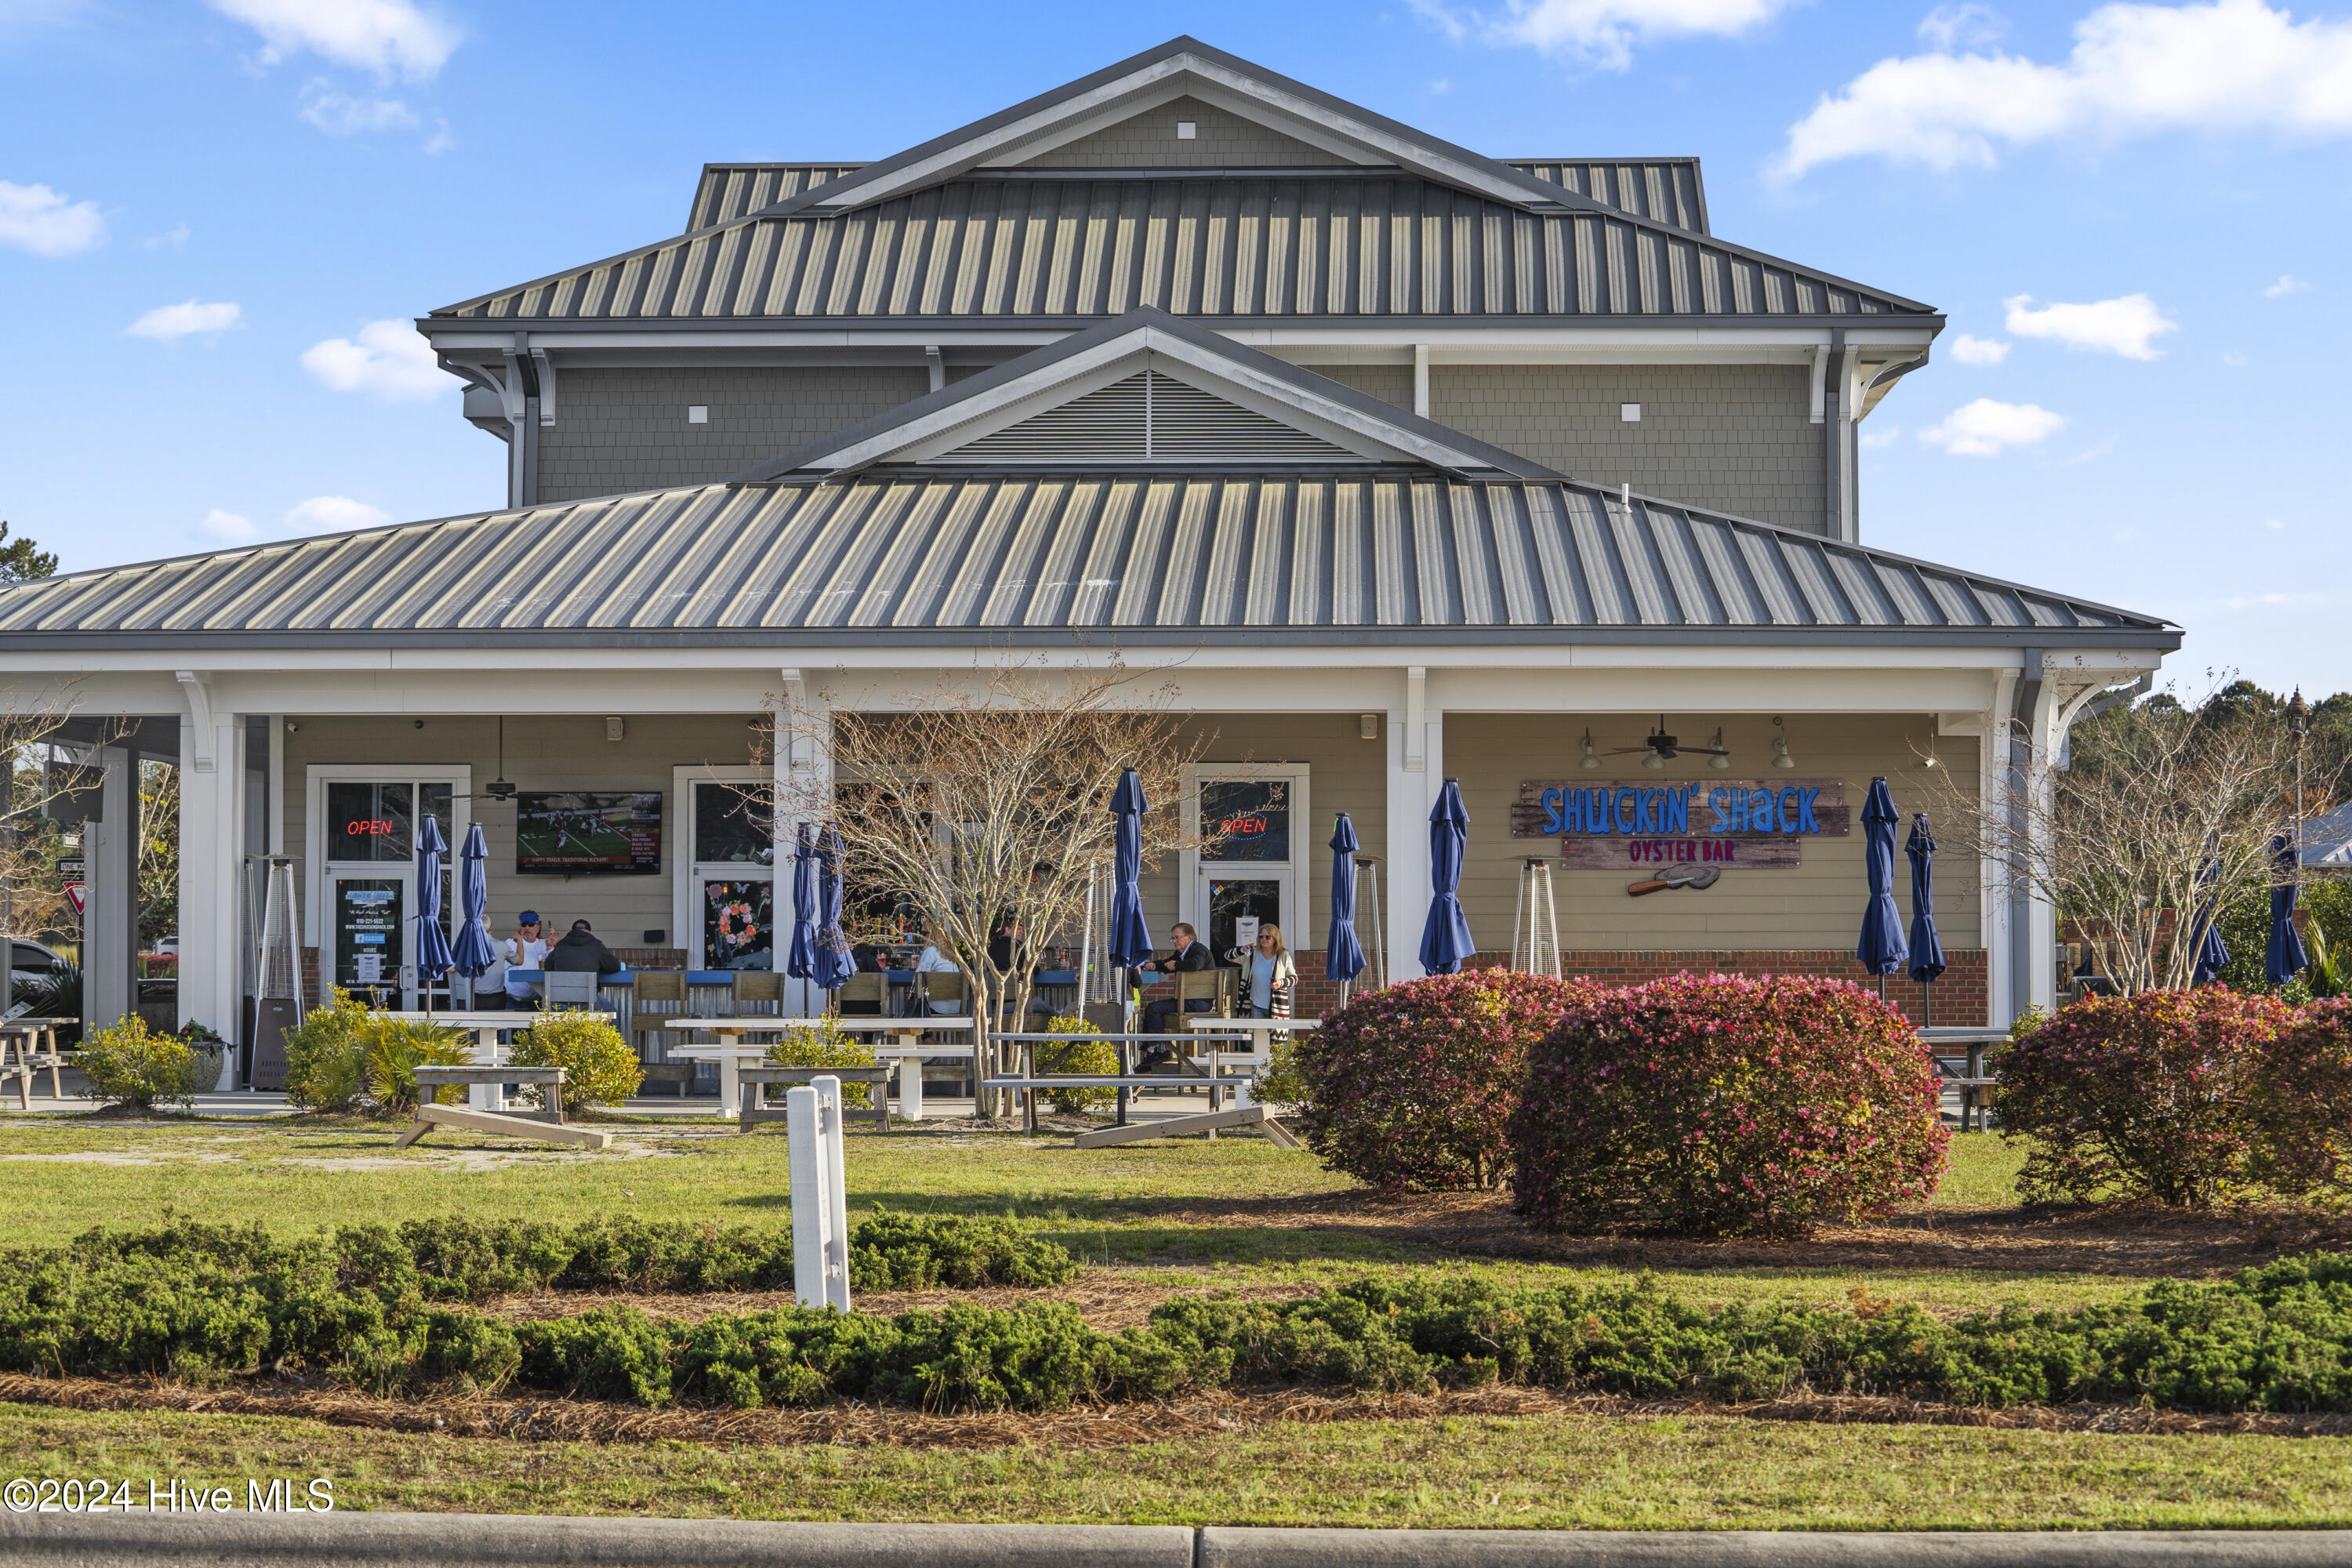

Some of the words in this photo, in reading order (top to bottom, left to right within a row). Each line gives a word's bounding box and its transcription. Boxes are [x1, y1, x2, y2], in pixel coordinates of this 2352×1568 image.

[347, 820, 393, 835] OPEN
[1220, 818, 1267, 833] OPEN
[1630, 840, 1696, 862] OYSTER
[1702, 840, 1735, 862] BAR
